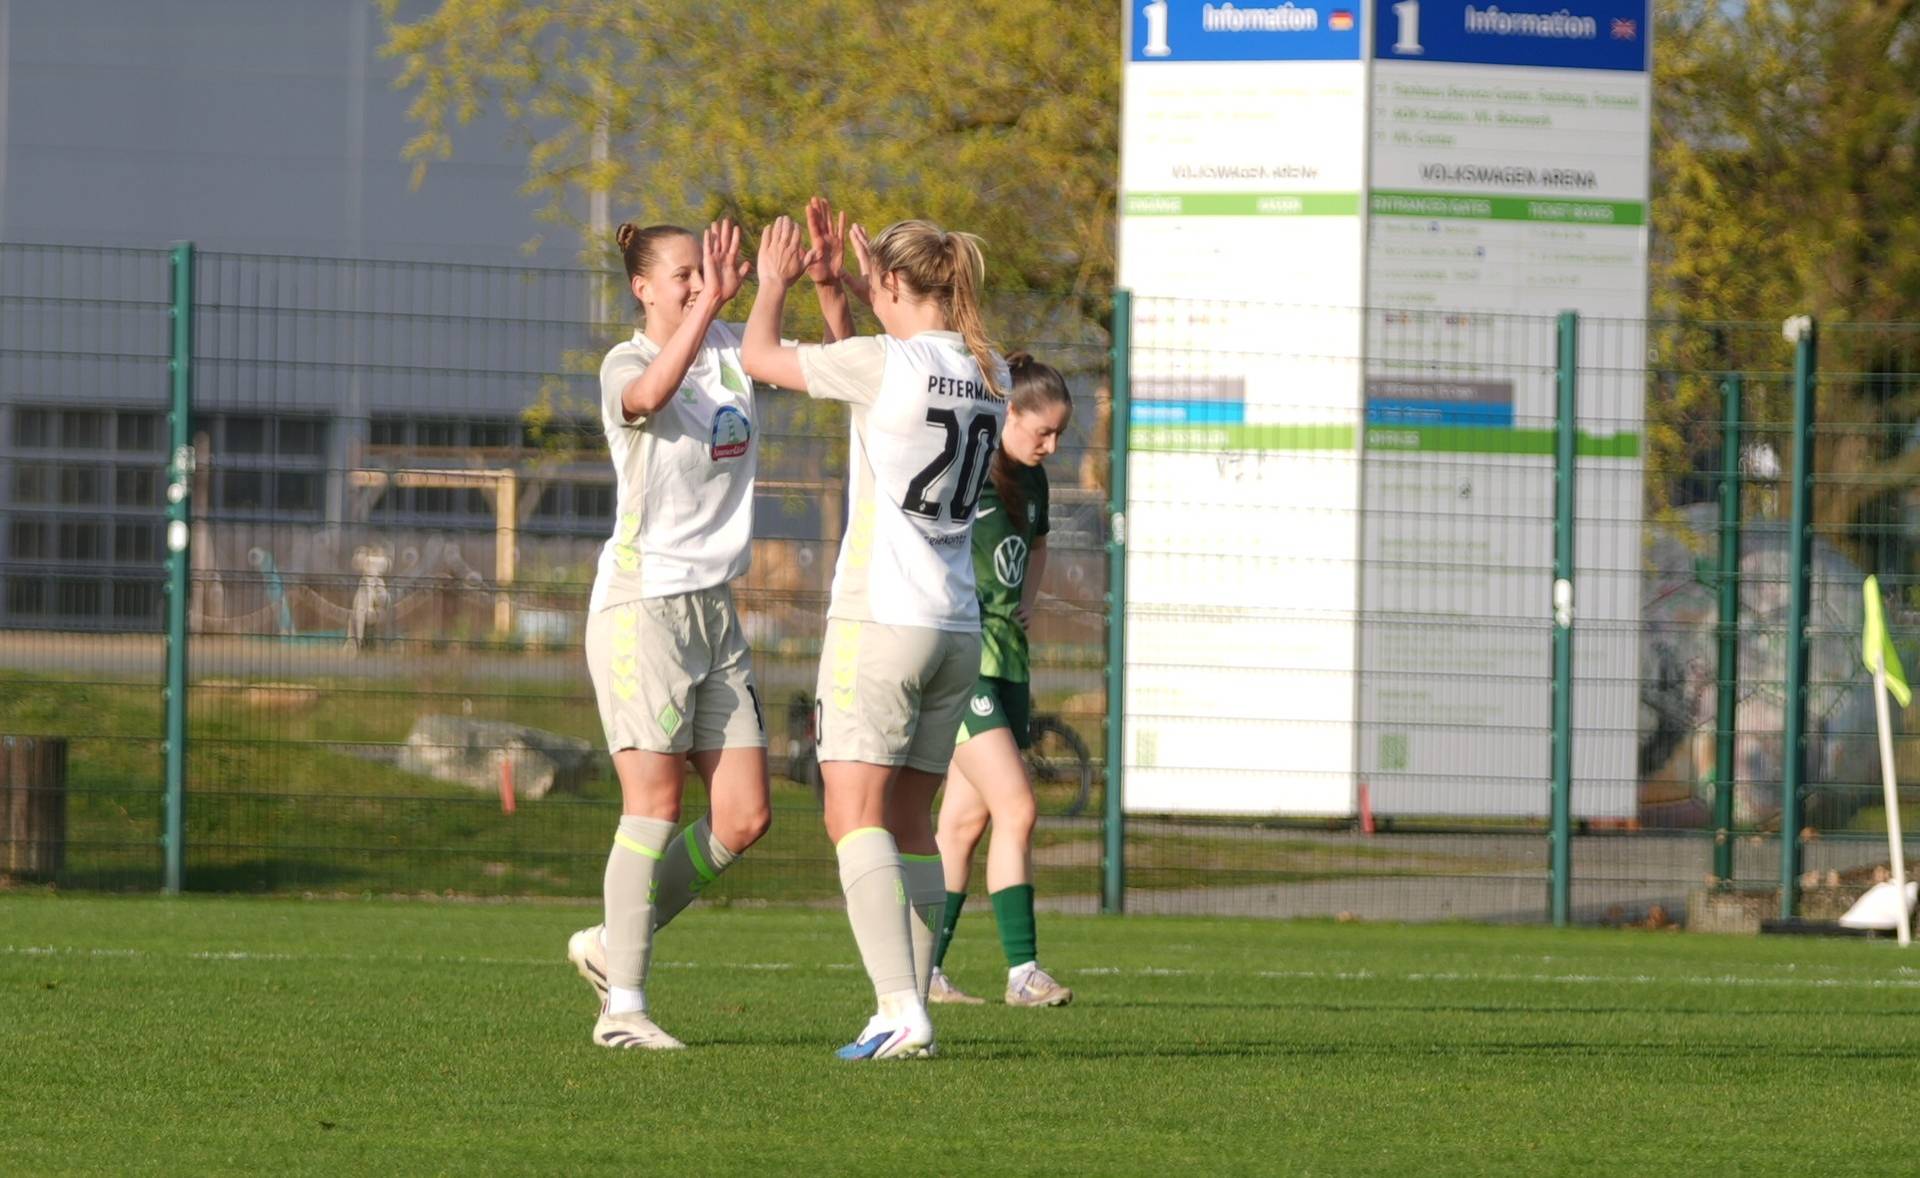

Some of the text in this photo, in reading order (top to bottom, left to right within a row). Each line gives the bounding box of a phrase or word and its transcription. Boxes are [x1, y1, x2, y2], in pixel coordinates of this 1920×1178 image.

[1143, 0, 1171, 56] 1
[1203, 2, 1318, 31] Information
[1391, 0, 1424, 55] 1
[1465, 5, 1597, 38] Information
[1420, 163, 1598, 190] VOLKSWAGEN ARENA
[901, 407, 996, 523] 20
